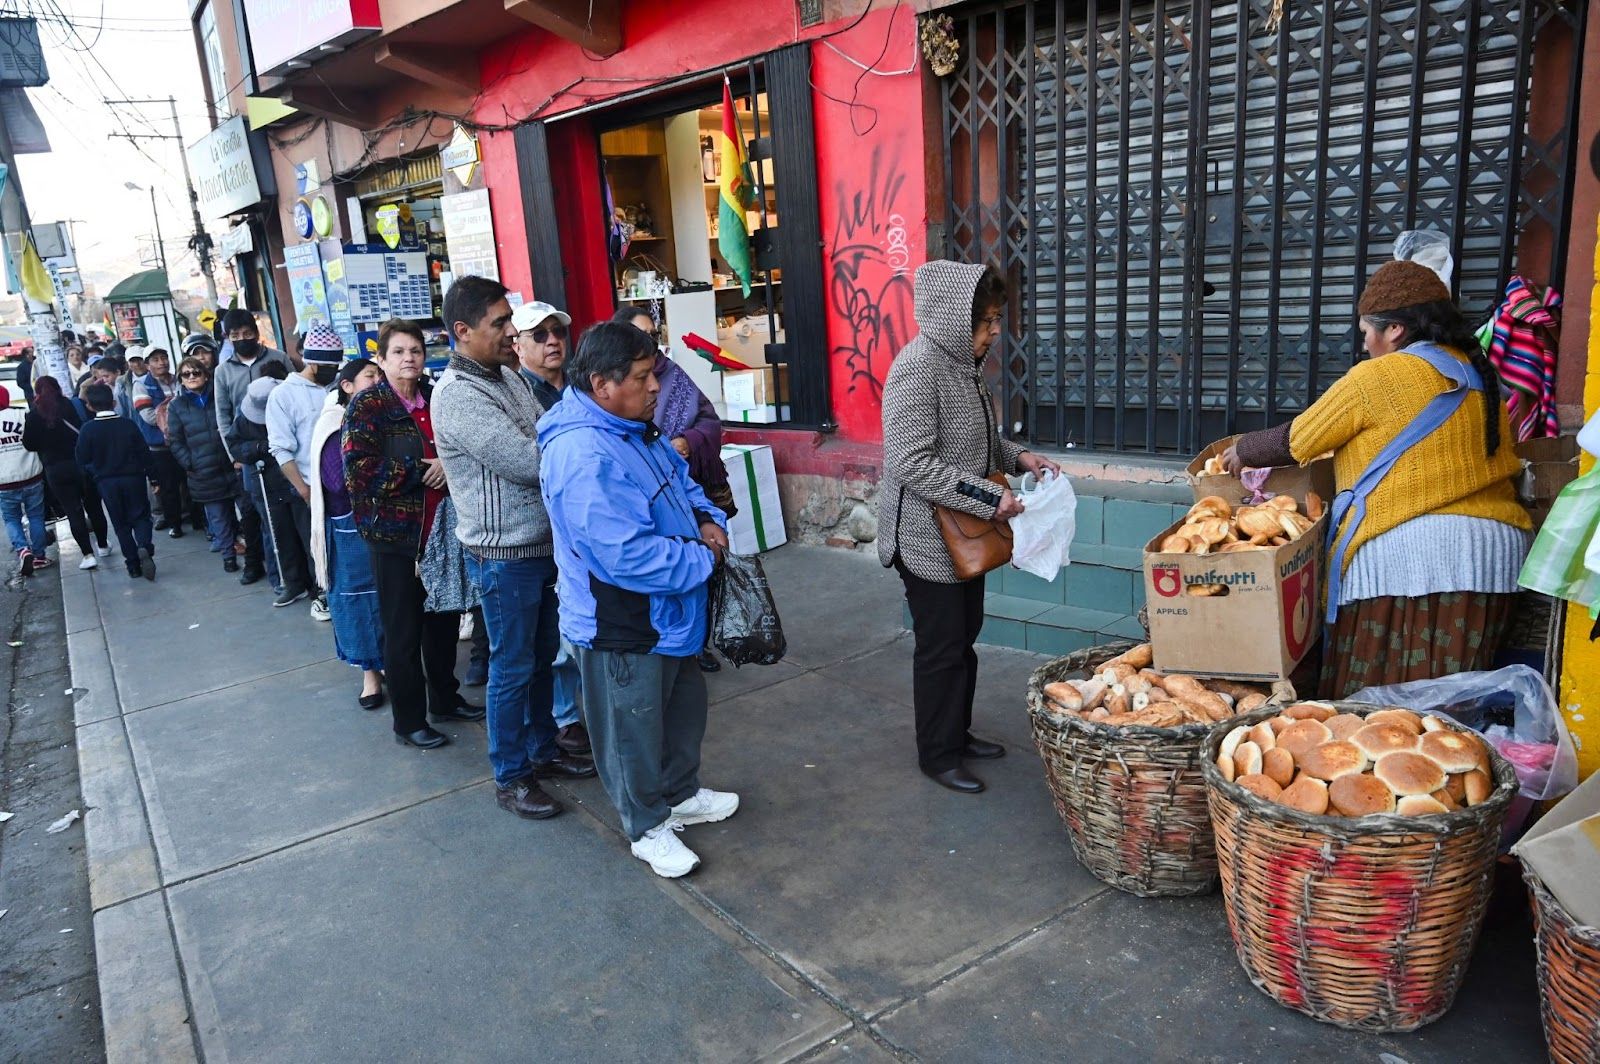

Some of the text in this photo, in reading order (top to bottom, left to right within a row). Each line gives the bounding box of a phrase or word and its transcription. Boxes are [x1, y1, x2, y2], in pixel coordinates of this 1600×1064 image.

[198, 161, 252, 205] Americana
[1183, 569, 1256, 585] unifrutti
[1238, 585, 1253, 595] from
[1156, 608, 1189, 616] APPLES
